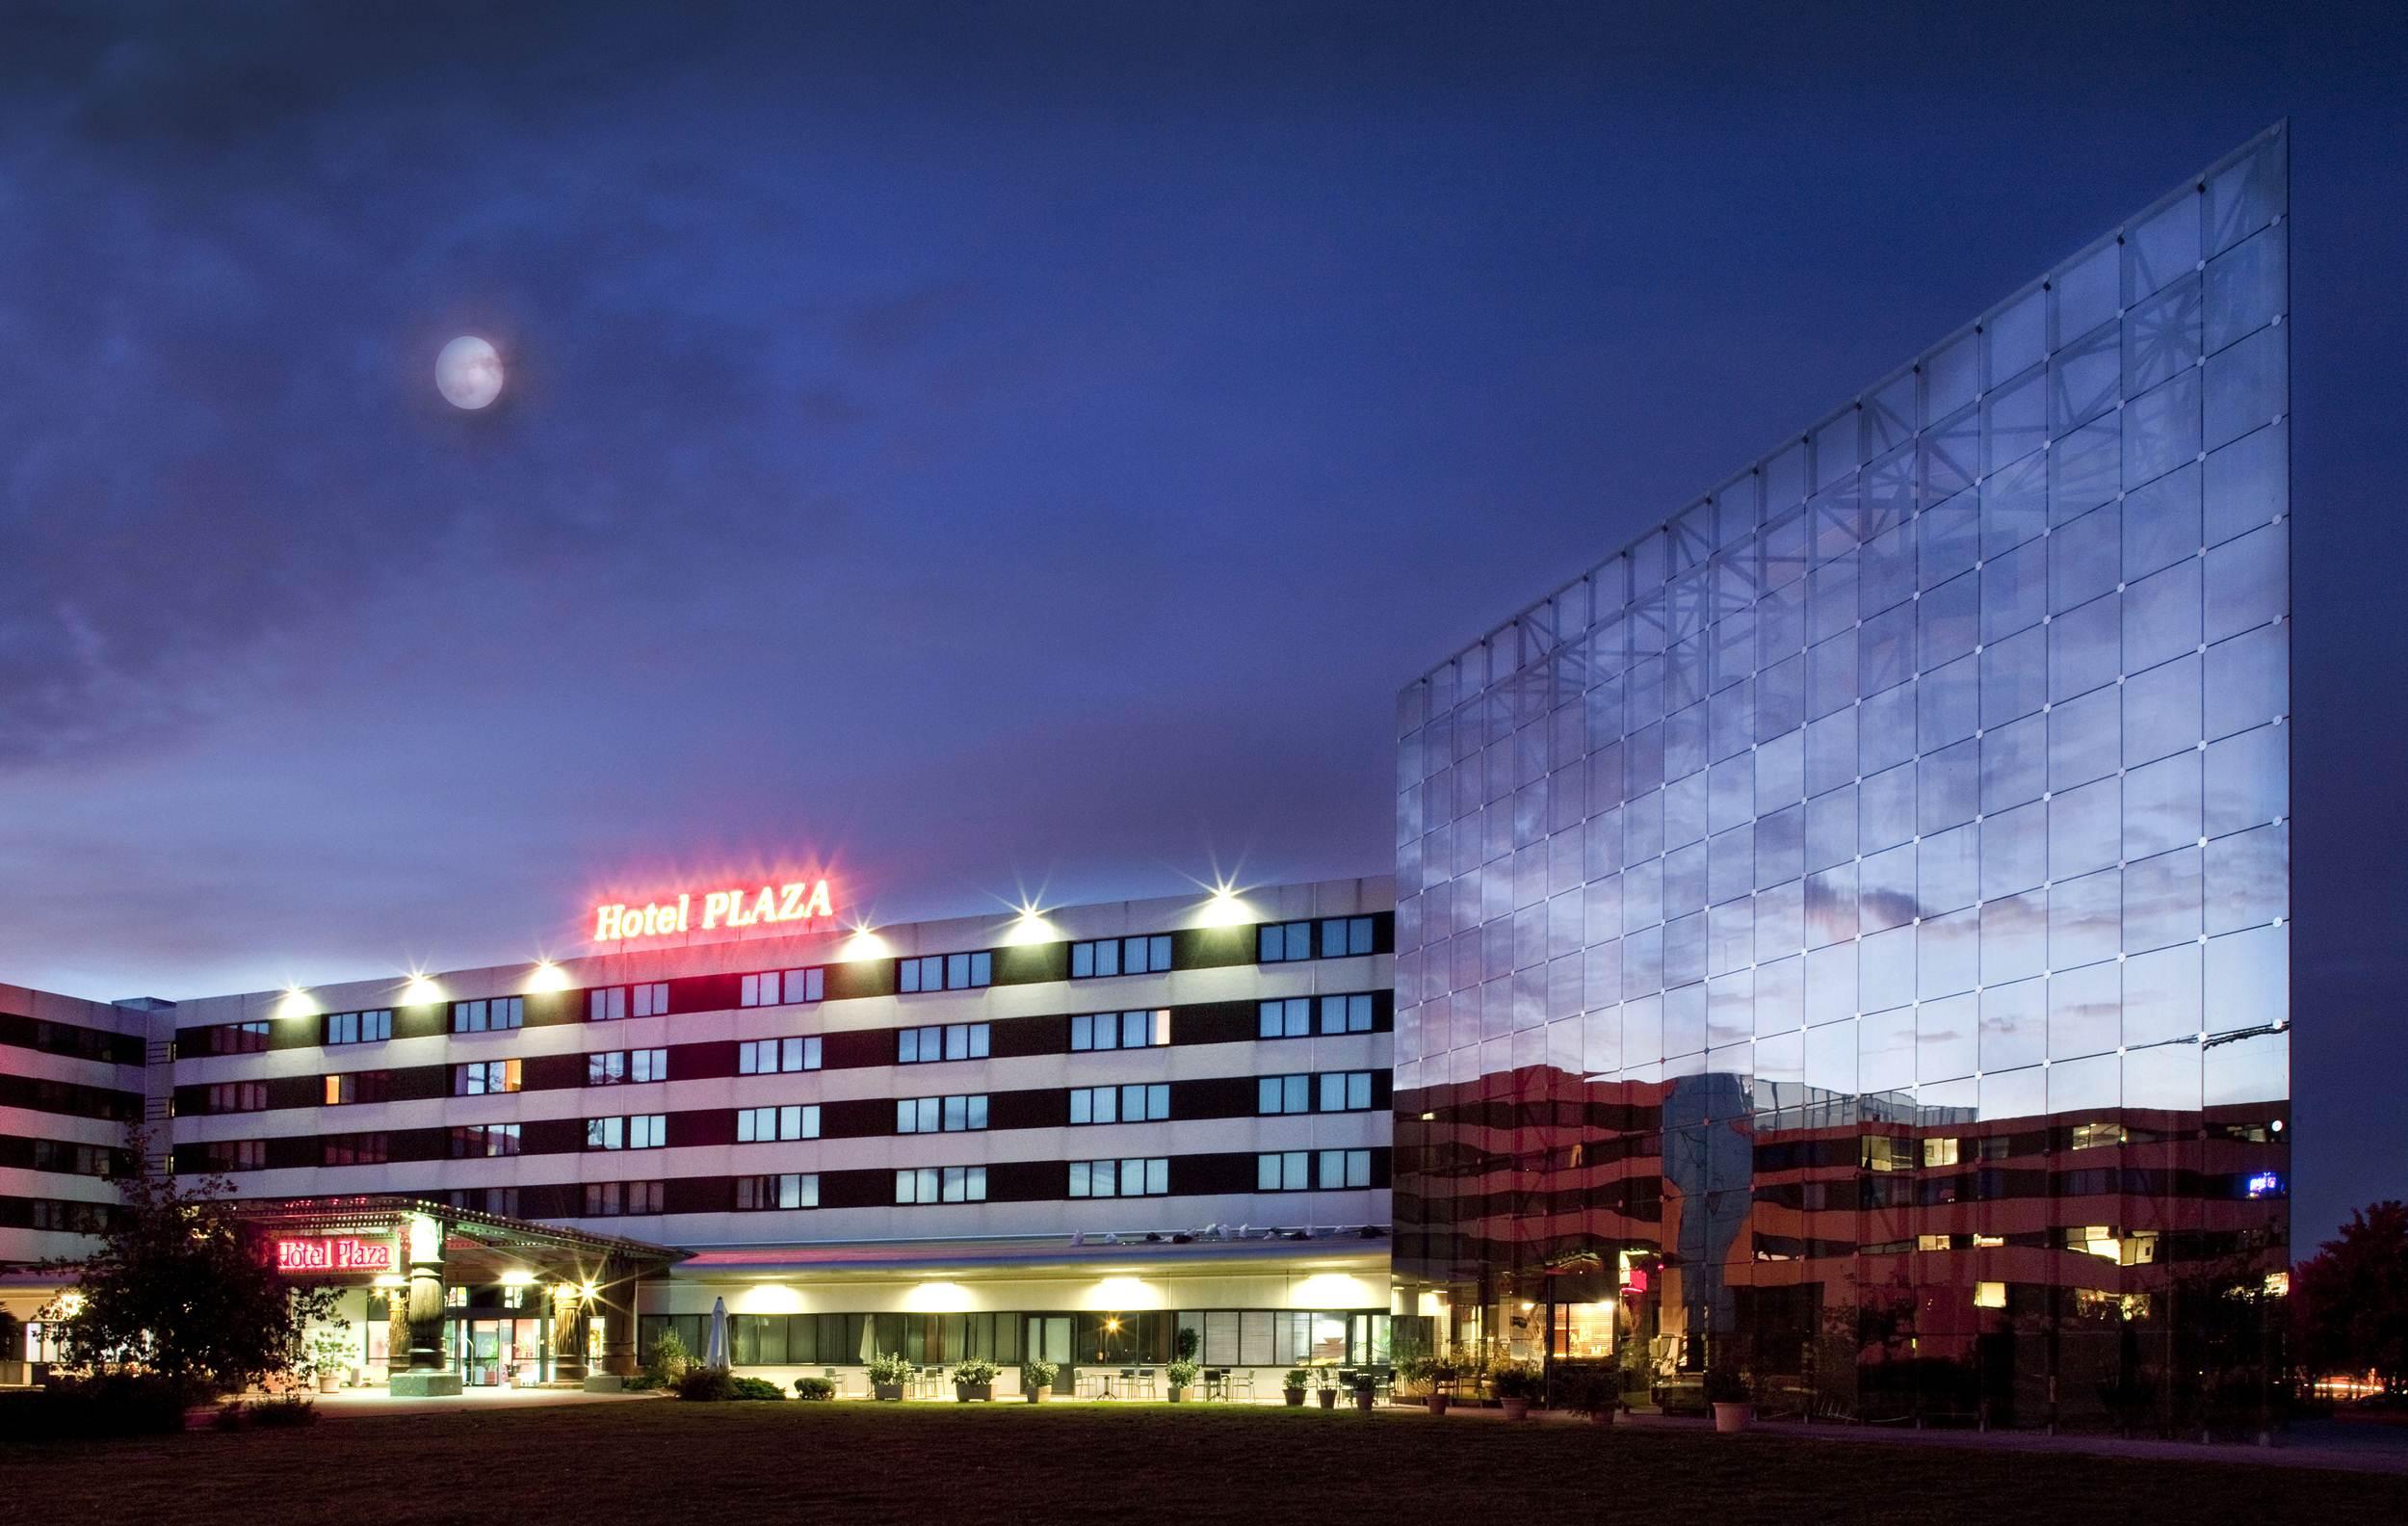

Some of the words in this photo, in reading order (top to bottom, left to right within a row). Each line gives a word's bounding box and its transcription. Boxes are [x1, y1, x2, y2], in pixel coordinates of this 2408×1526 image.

[593, 893, 690, 941] Hotel
[701, 880, 833, 930] PLAZA
[338, 1239, 392, 1267] Plaza
